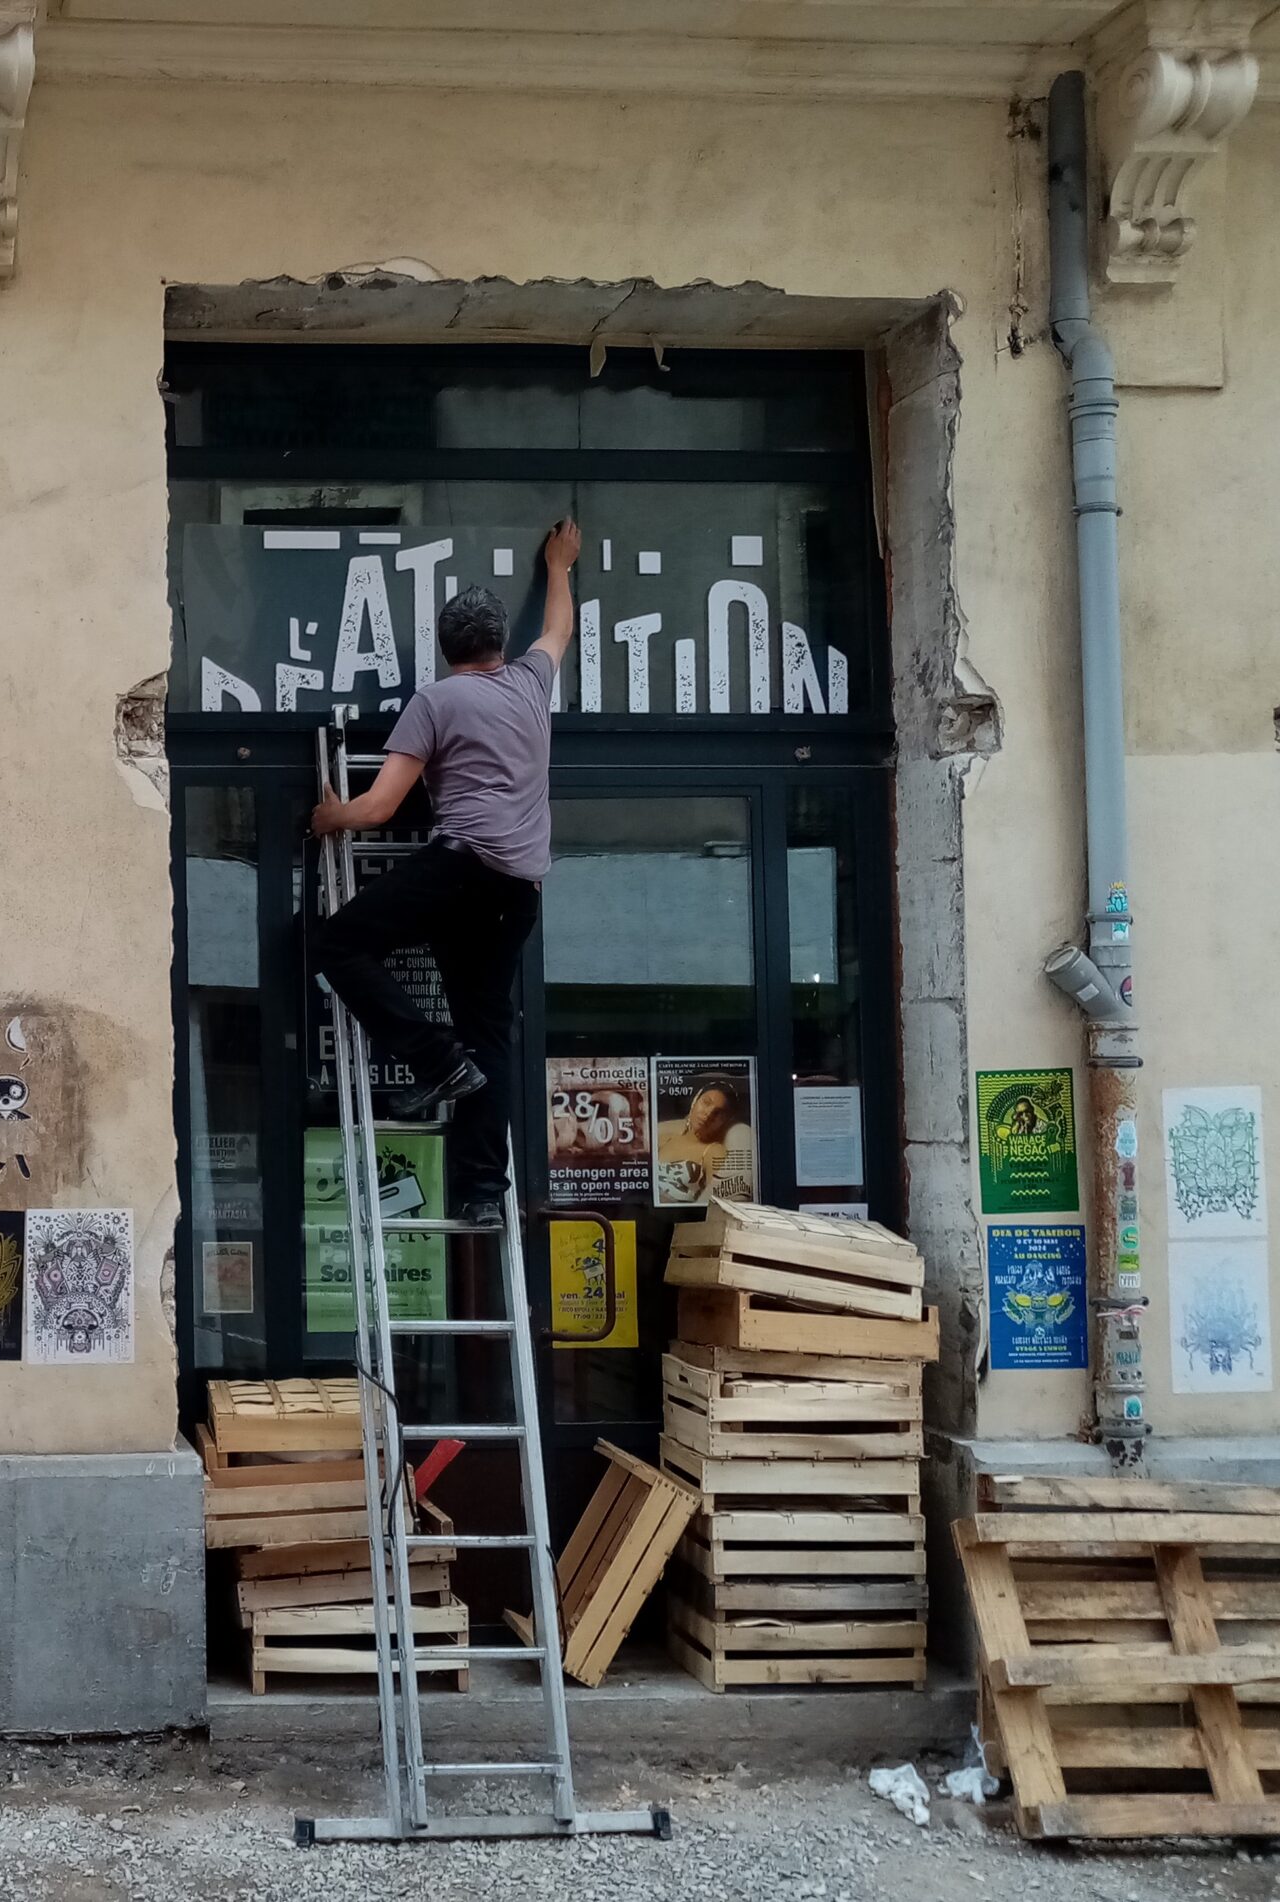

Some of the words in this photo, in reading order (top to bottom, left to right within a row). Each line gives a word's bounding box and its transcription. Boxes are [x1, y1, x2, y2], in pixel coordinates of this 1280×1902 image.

[412, 970, 423, 982] DU
[659, 1076, 683, 1085] 17/05
[668, 1087, 693, 1096] 05/07
[1008, 1134, 1046, 1145] WALLACE
[549, 1167, 615, 1181] schengen
[619, 1168, 649, 1179] area
[549, 1180, 560, 1191] is
[563, 1181, 577, 1190] an
[581, 1181, 610, 1192] open
[613, 1180, 649, 1192] space
[1015, 1229, 1030, 1238] DE
[583, 1287, 604, 1299] 24
